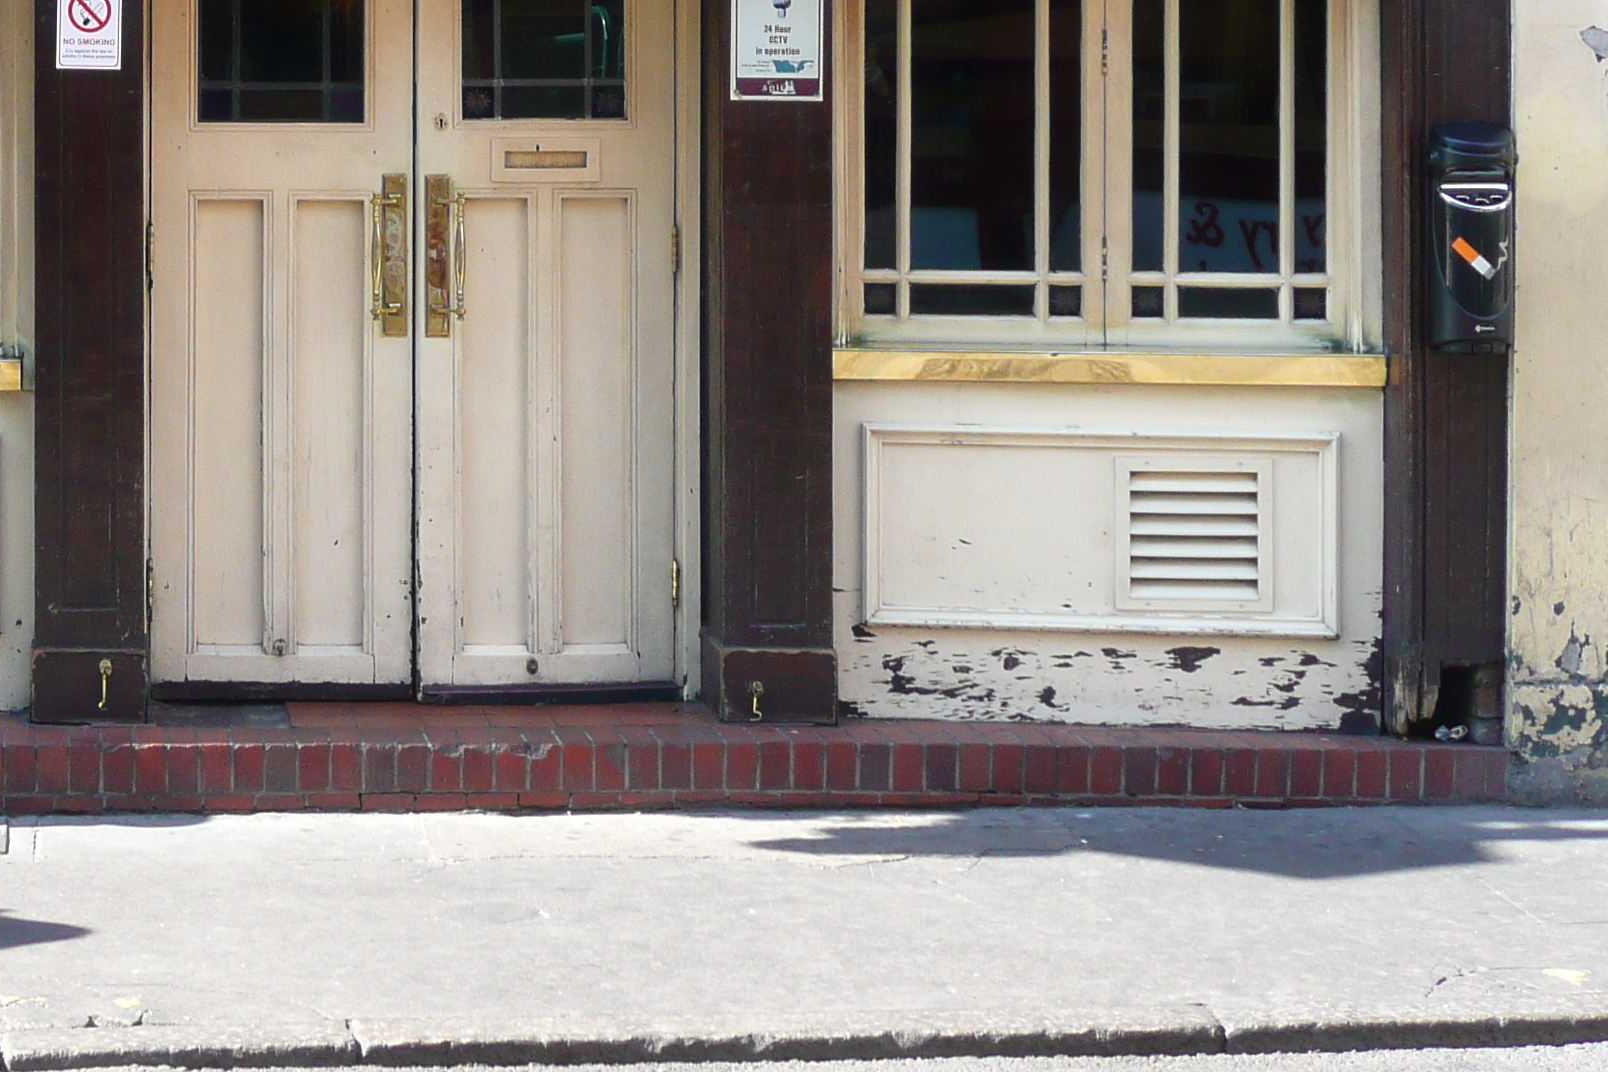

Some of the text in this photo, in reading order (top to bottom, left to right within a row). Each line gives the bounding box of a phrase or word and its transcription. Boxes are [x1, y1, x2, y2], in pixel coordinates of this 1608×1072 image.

[775, 24, 792, 34] Hour
[63, 38, 116, 46] NO SMOKING
[768, 35, 788, 44] CCTV
